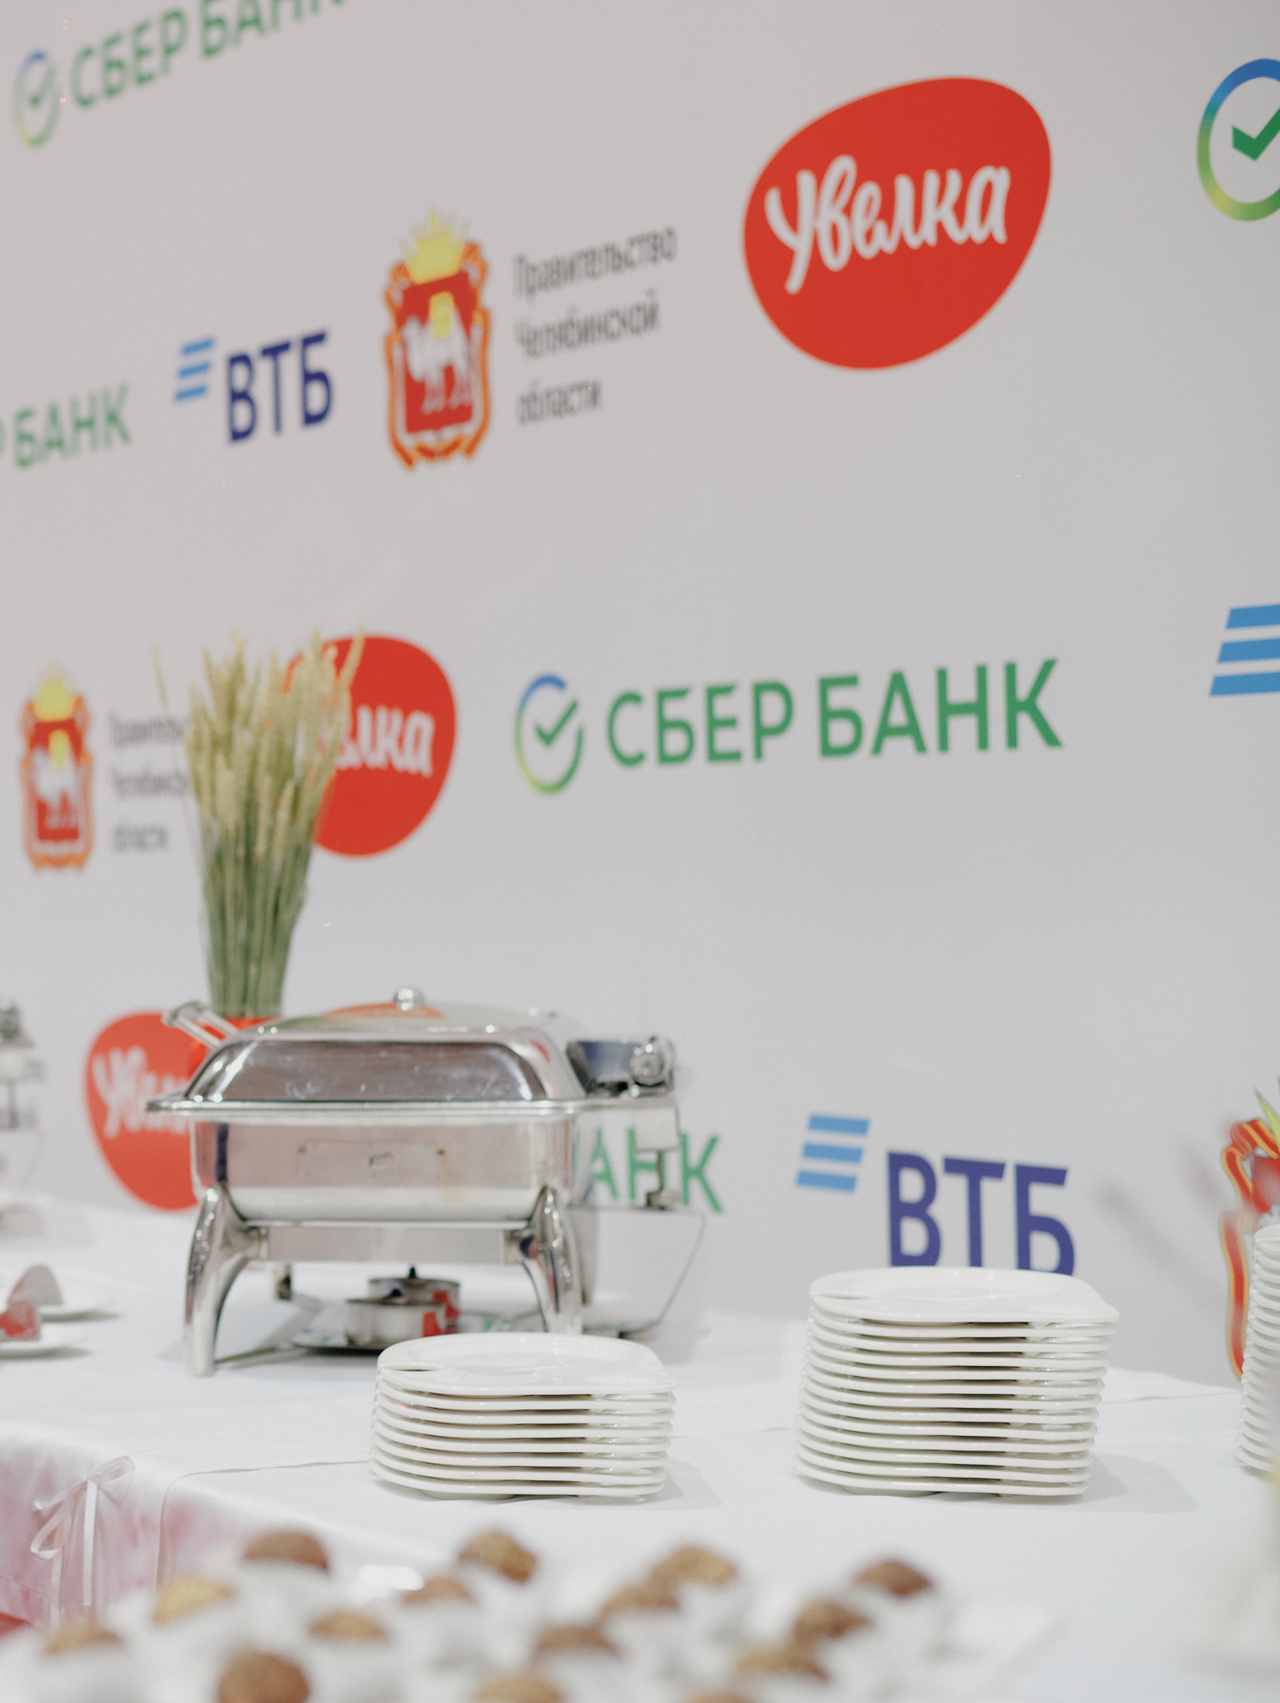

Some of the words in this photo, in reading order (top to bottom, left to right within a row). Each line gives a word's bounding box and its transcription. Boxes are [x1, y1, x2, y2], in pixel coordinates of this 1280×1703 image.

[764, 154, 1011, 294] Увелка
[228, 331, 332, 442] ВТБ
[606, 680, 795, 768] СБЕР
[817, 657, 1064, 759] БАНК
[886, 1149, 1075, 1275] ВТБ
